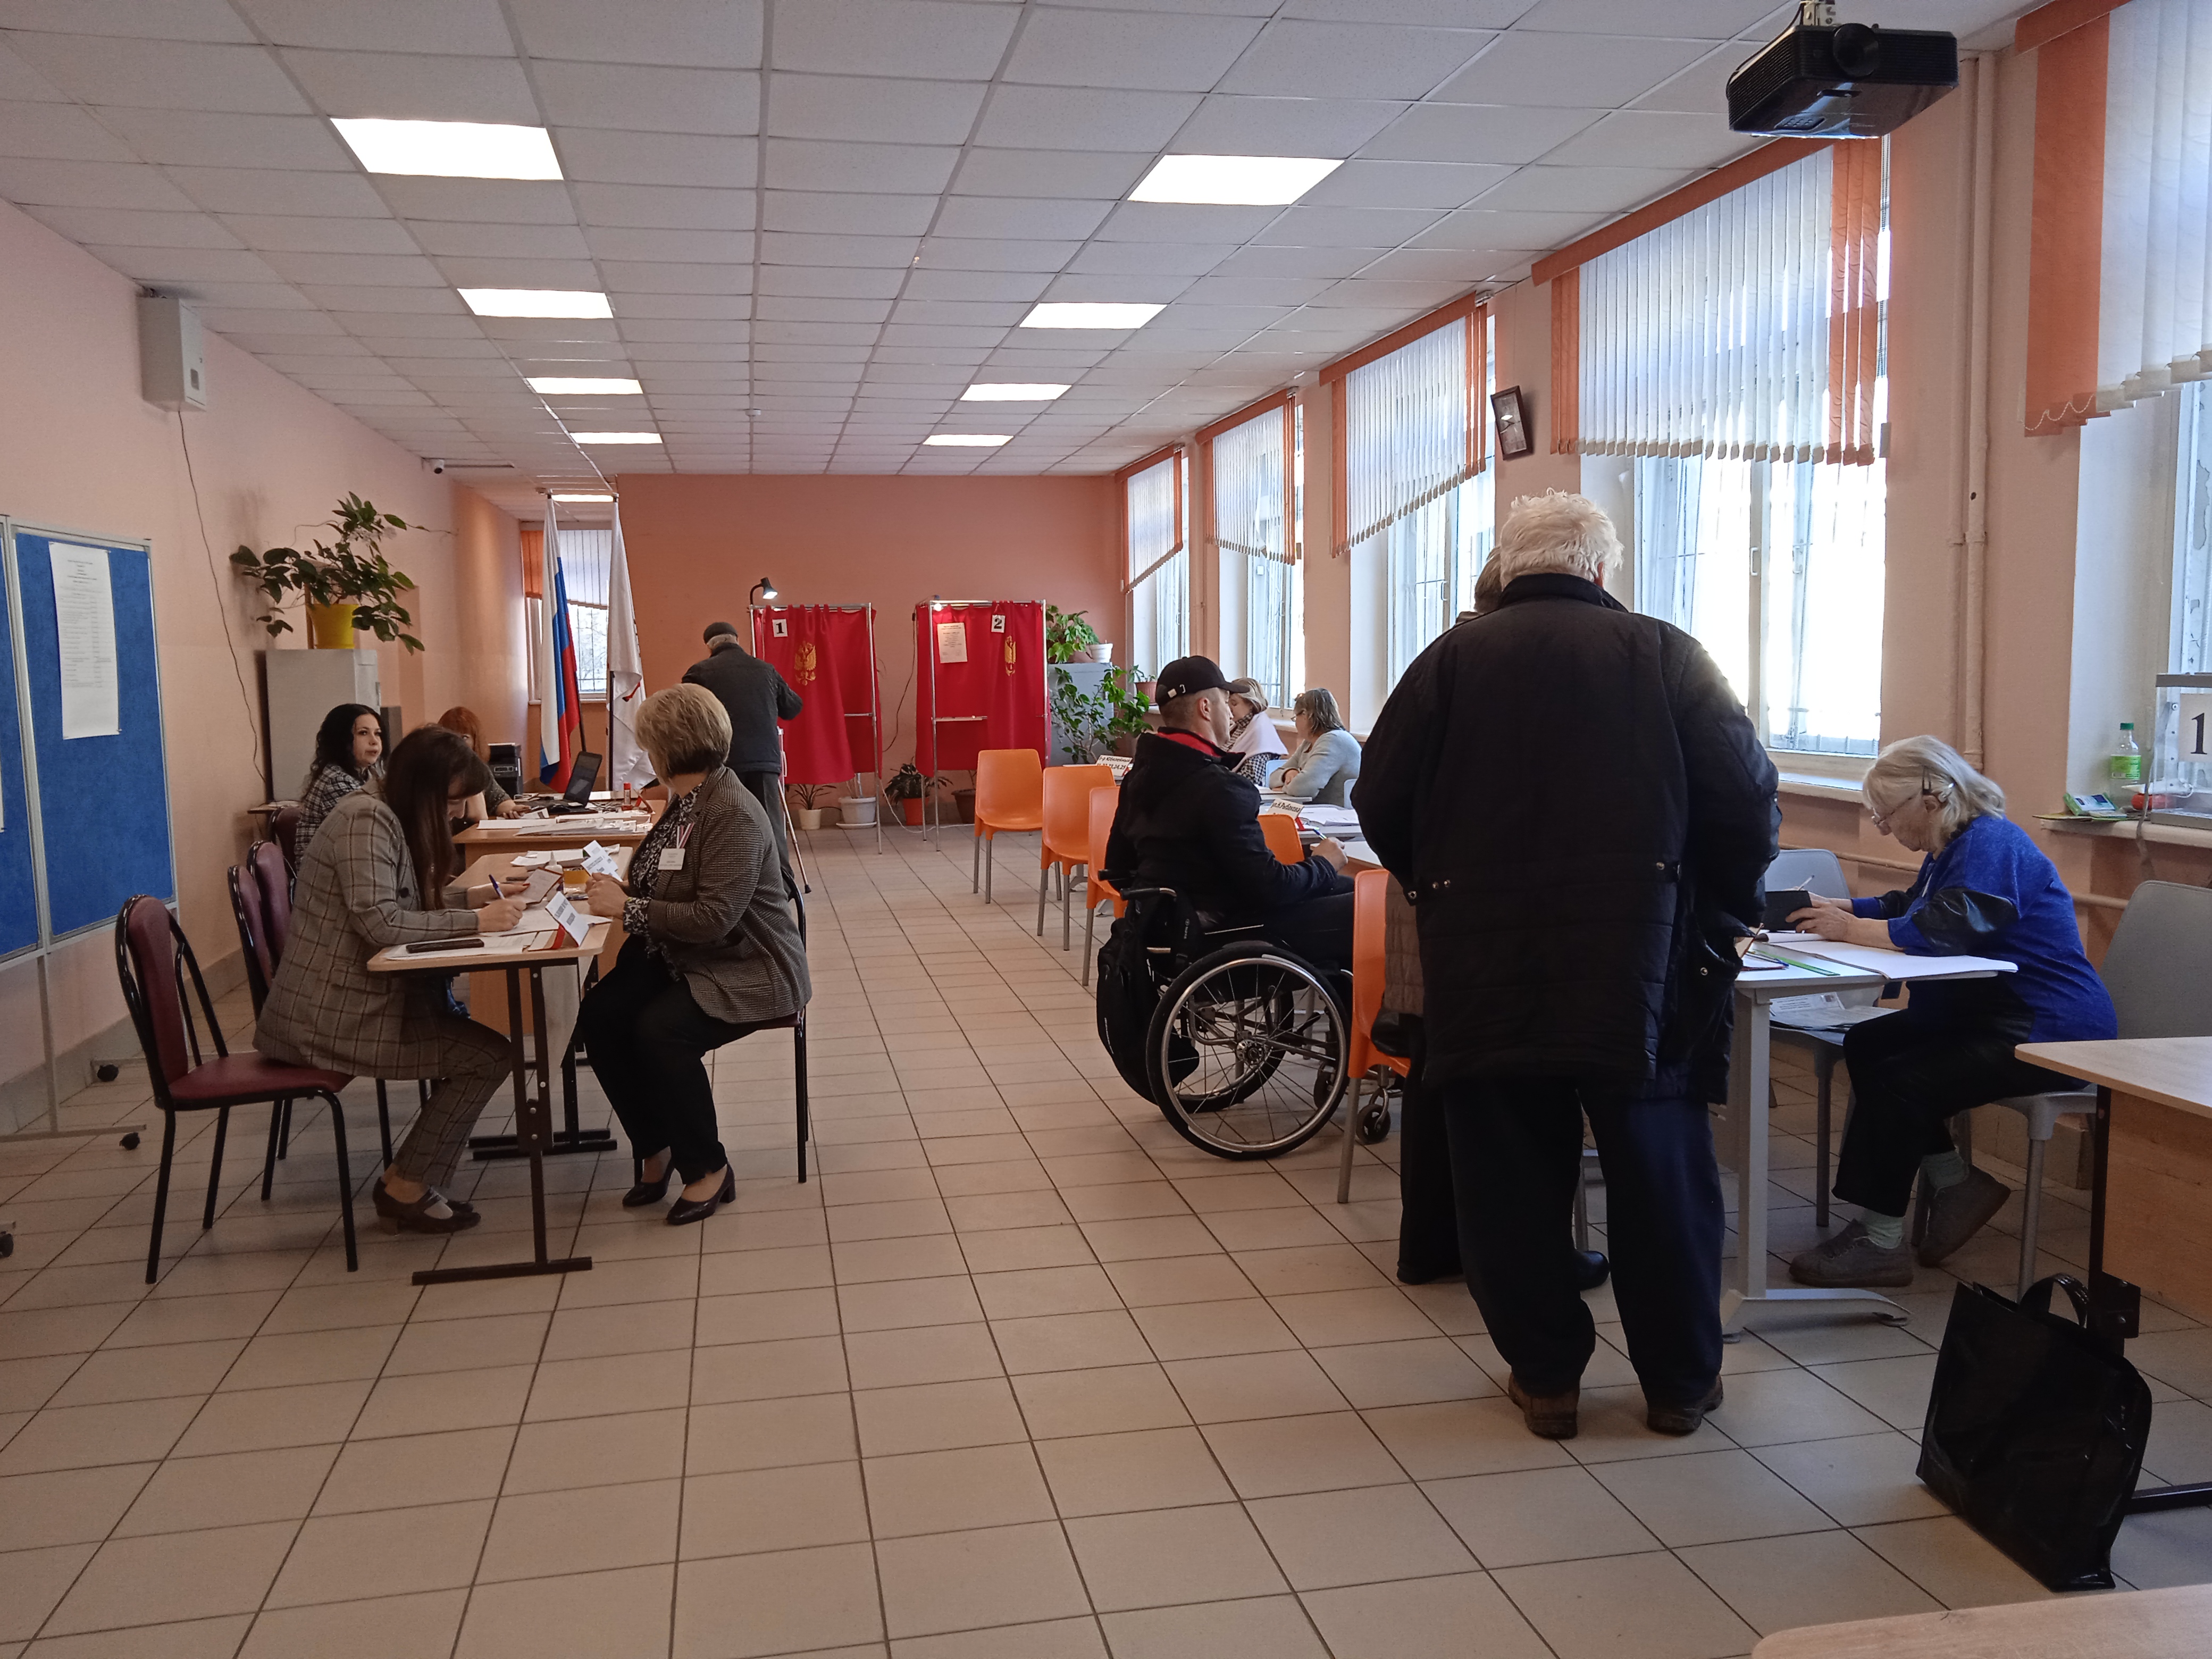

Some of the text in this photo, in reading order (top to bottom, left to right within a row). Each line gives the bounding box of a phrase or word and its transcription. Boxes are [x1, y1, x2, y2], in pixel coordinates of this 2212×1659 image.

[776, 622, 784, 634] 1
[994, 618, 1002, 630] 2
[2190, 713, 2208, 755] 1
